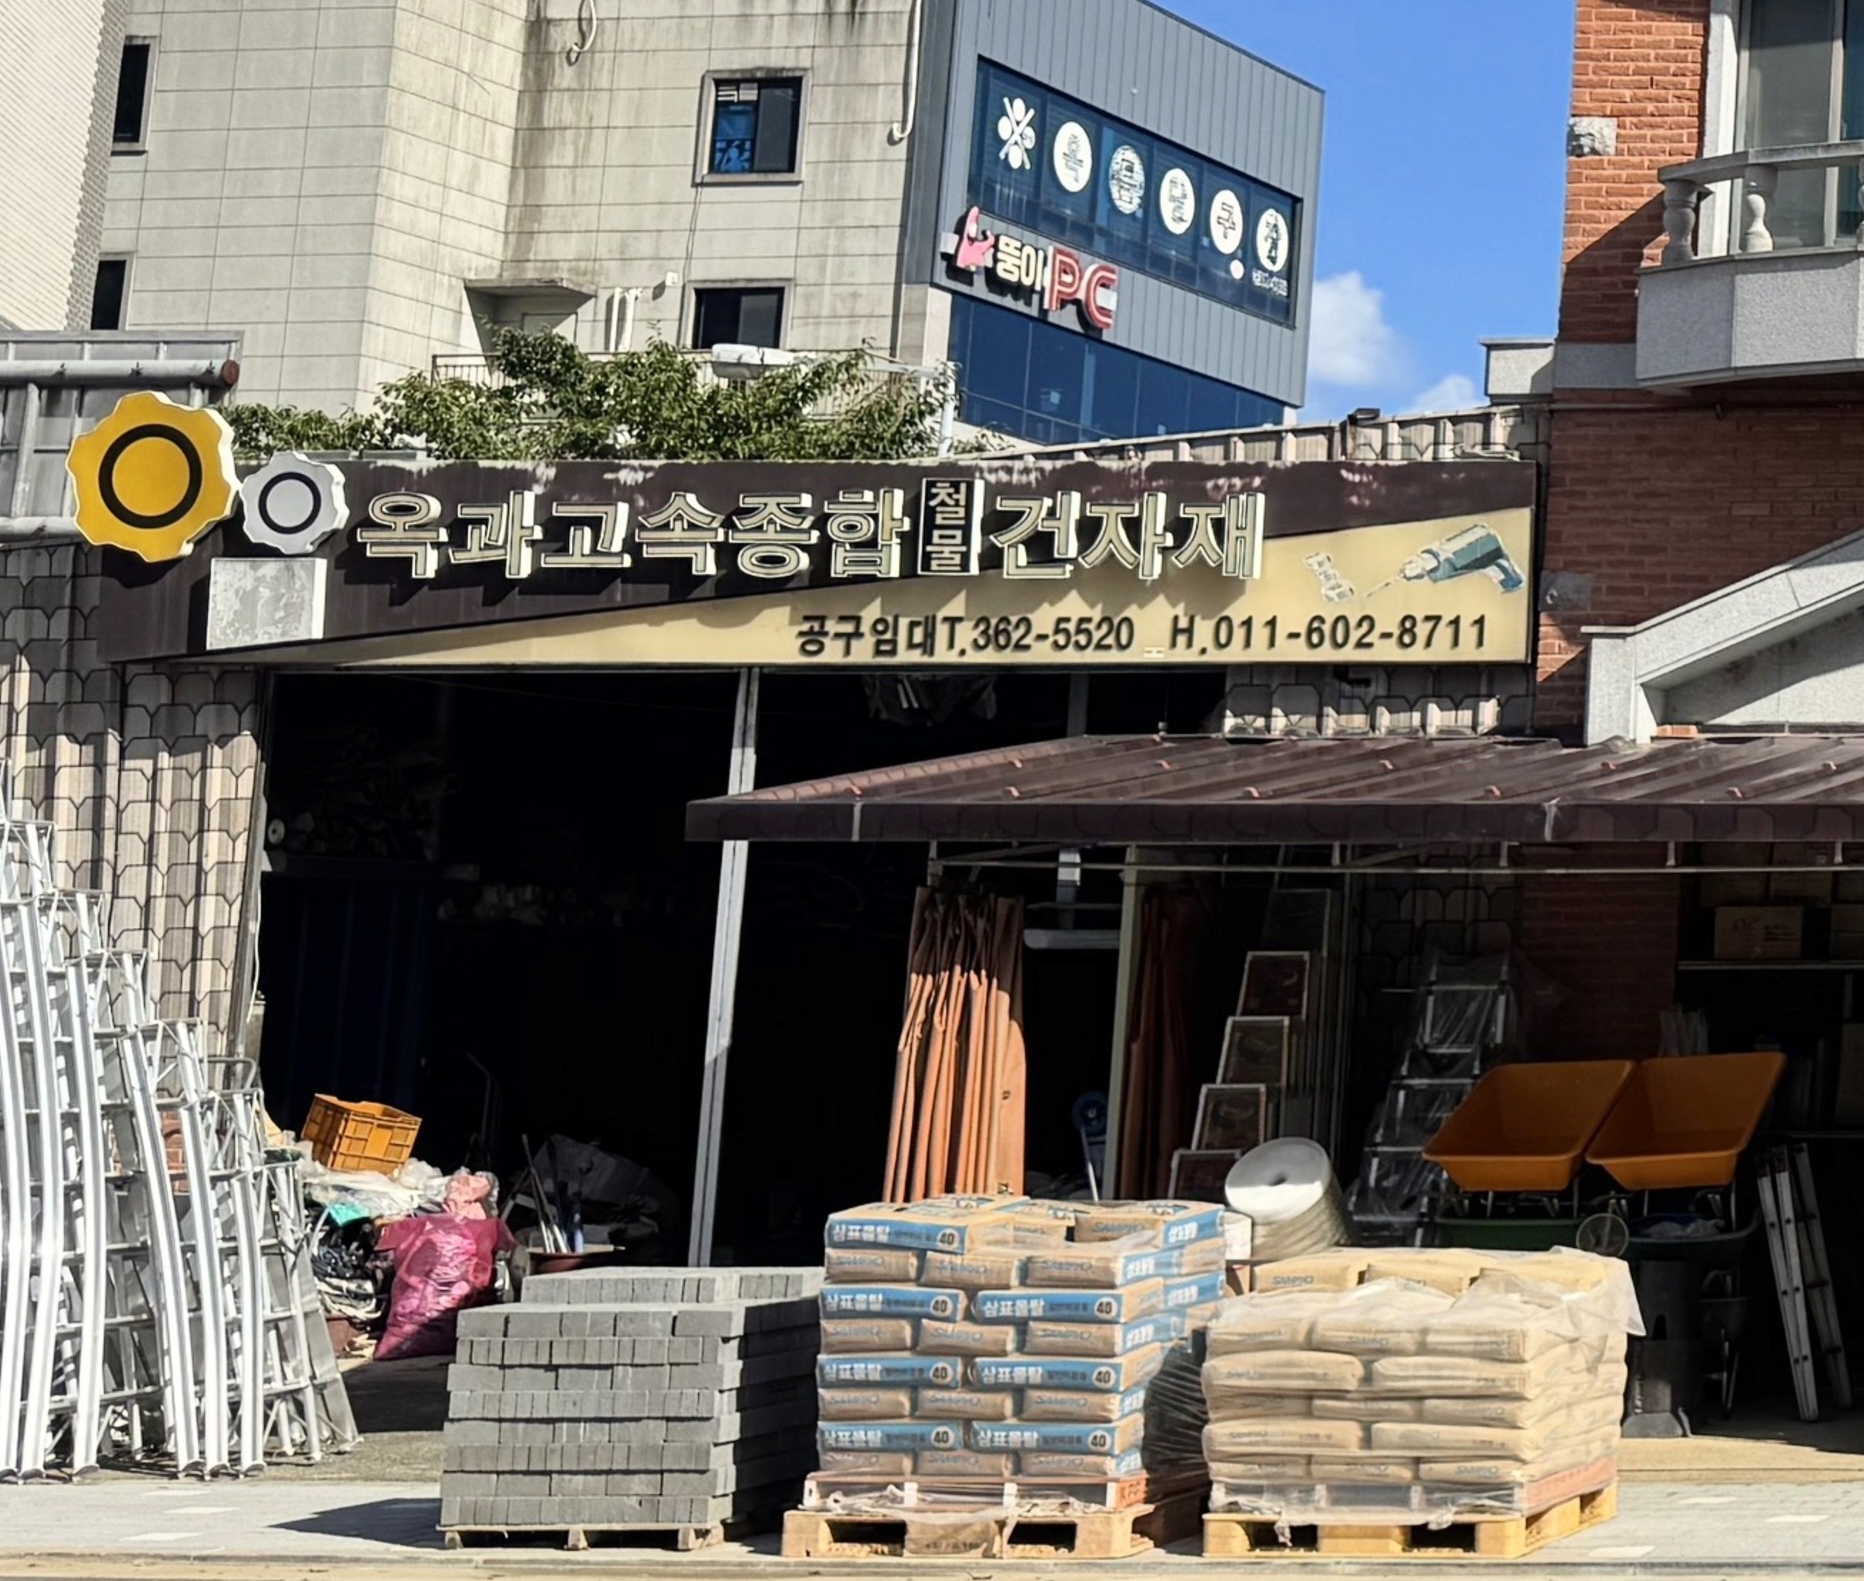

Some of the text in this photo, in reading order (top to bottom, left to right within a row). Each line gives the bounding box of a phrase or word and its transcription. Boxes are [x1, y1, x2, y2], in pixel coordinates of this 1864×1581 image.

[1045, 246, 1118, 330] PC
[926, 480, 970, 573] 철물
[989, 490, 1267, 580] 건자재
[938, 1232, 956, 1246] 40
[931, 1299, 949, 1314] 40
[1096, 1300, 1113, 1315] 40
[932, 1365, 948, 1380] 40
[1094, 1369, 1111, 1384] 40
[933, 1430, 949, 1445] 40
[1090, 1434, 1107, 1449] 40
